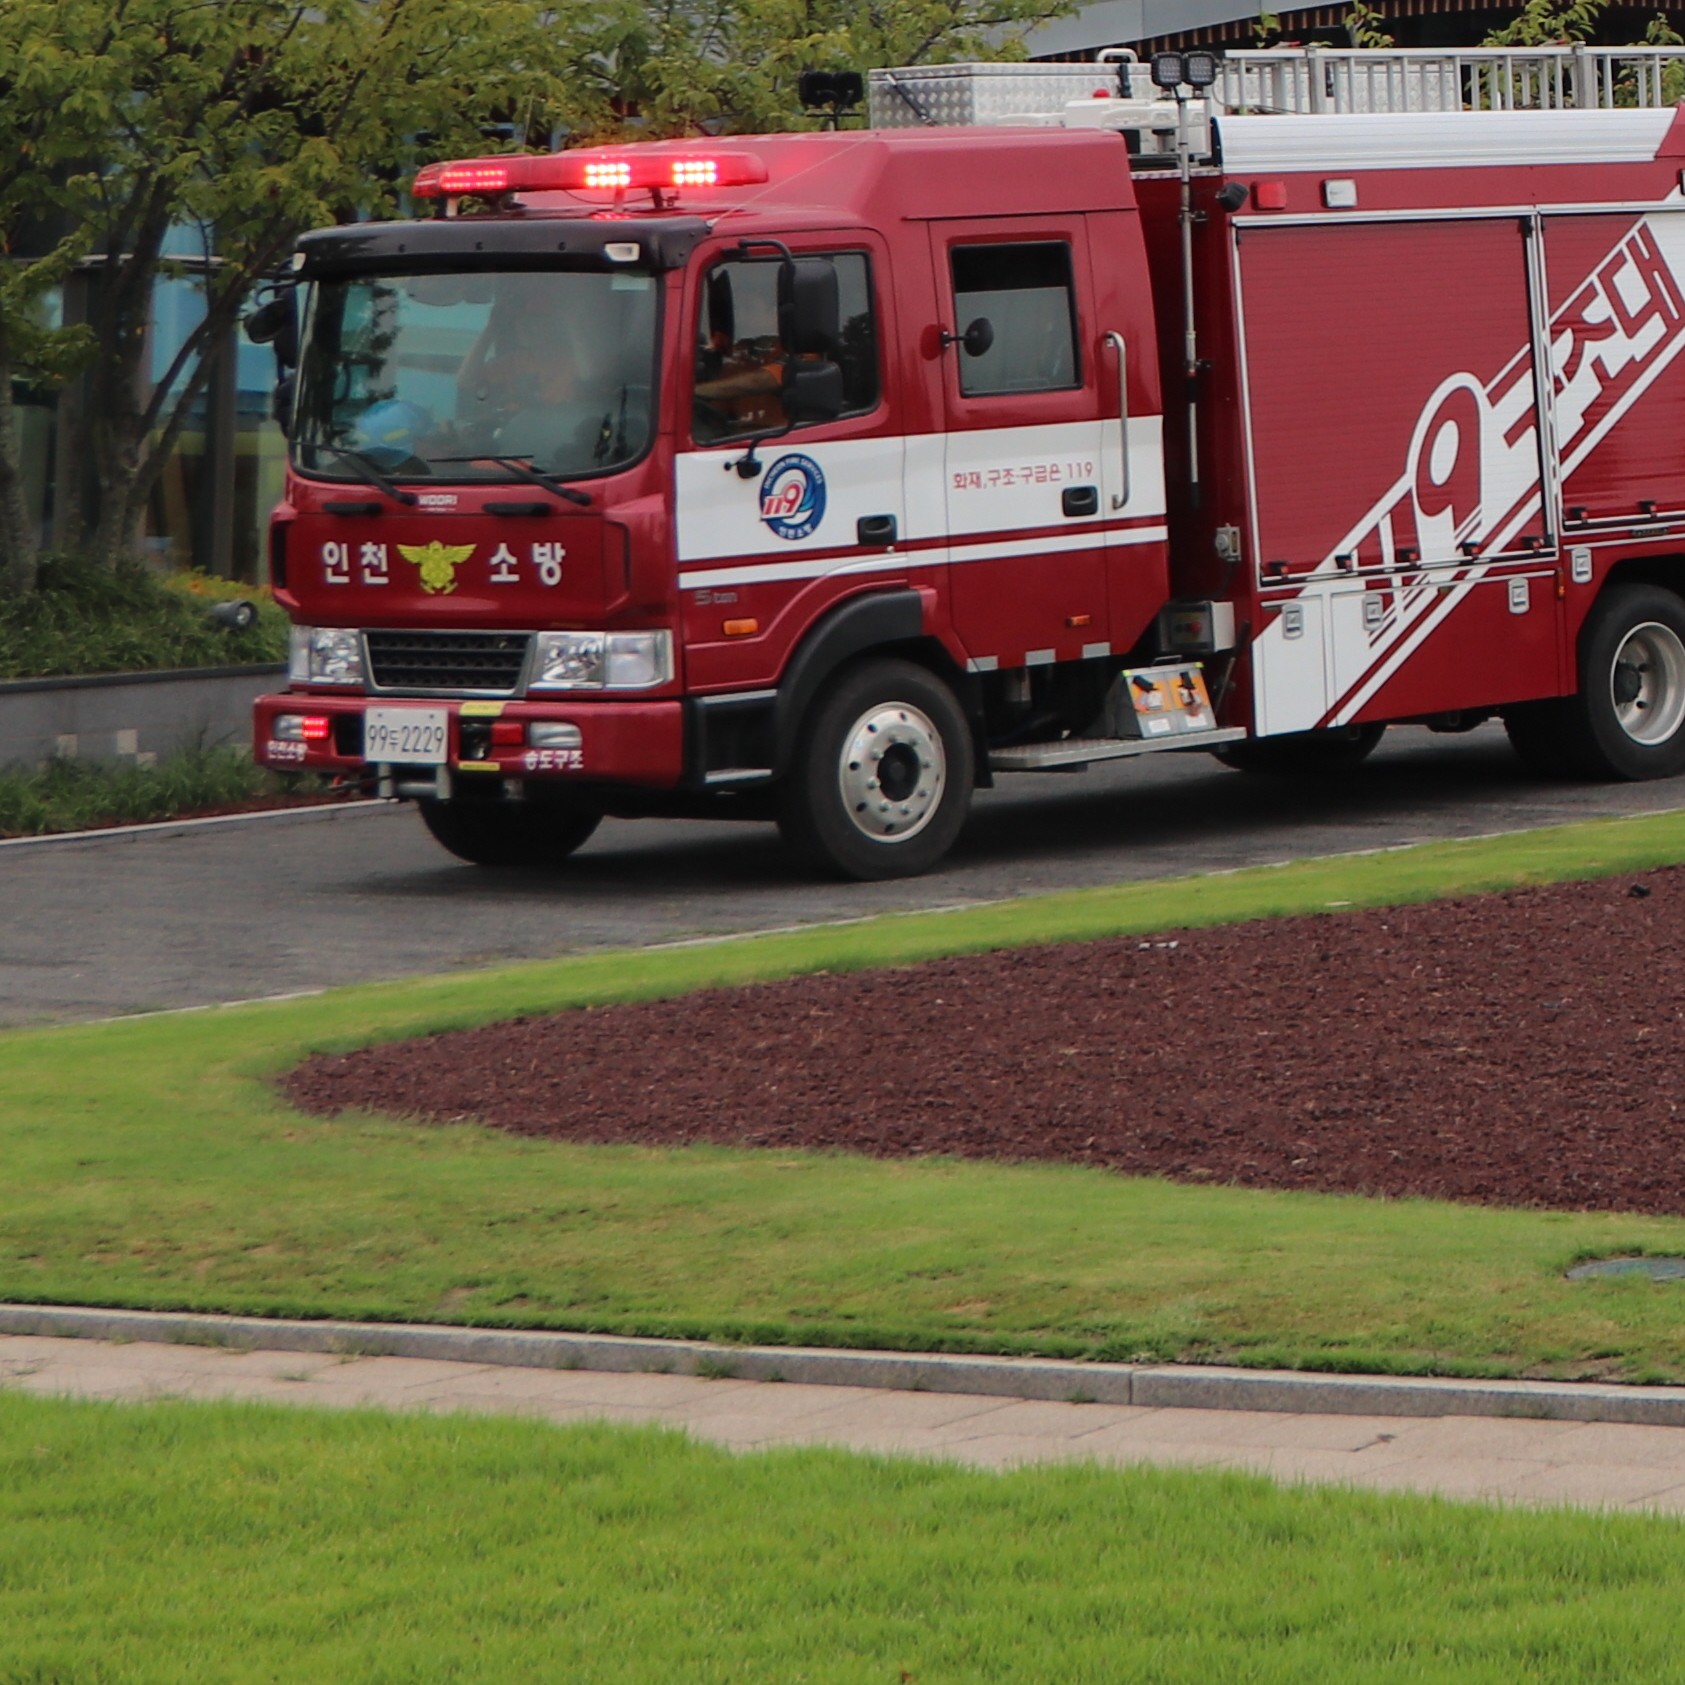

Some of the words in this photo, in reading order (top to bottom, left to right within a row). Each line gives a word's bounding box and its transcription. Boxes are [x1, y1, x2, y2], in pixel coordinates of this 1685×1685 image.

[1067, 461, 1094, 479] 119
[763, 482, 802, 516] 119
[322, 541, 389, 585] 인천
[489, 542, 566, 586] 소방
[367, 724, 446, 754] 99두2229
[523, 749, 585, 771] 송도구조
